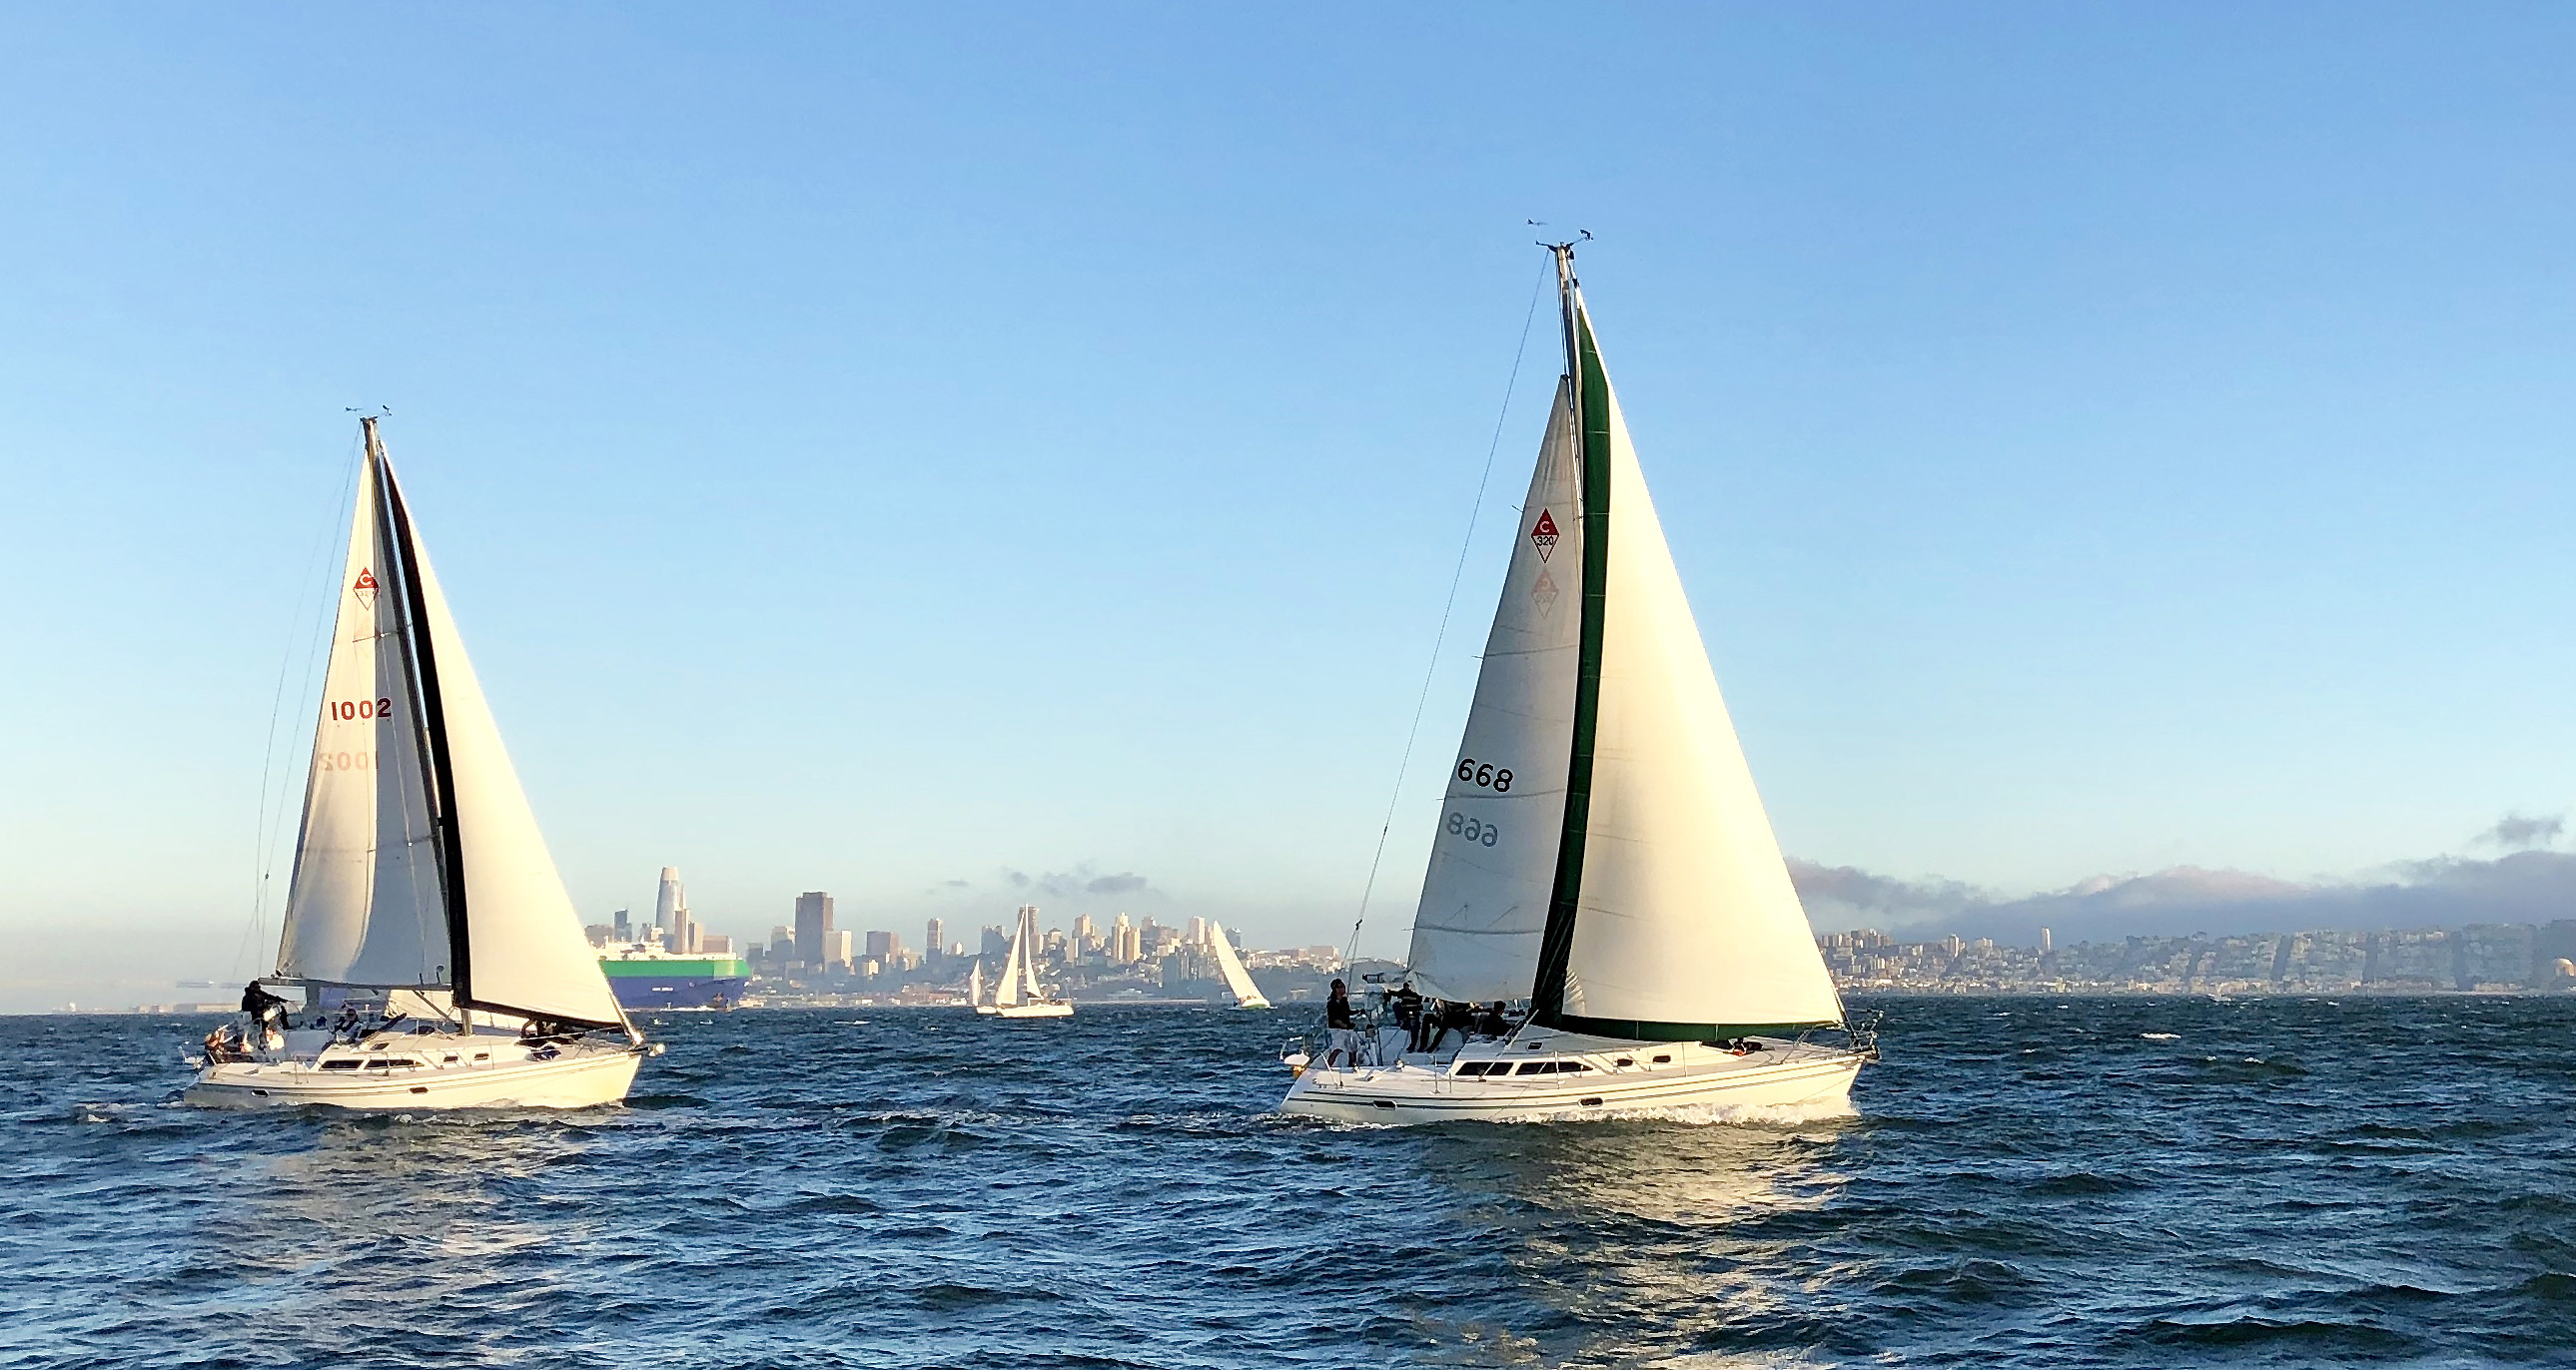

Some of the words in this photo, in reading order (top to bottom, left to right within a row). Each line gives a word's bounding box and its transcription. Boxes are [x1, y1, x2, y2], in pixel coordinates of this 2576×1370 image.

[1539, 520, 1550, 533] C
[1537, 536, 1554, 546] 320
[360, 573, 374, 586] C
[331, 698, 392, 721] 1002
[1458, 758, 1513, 793] 668
